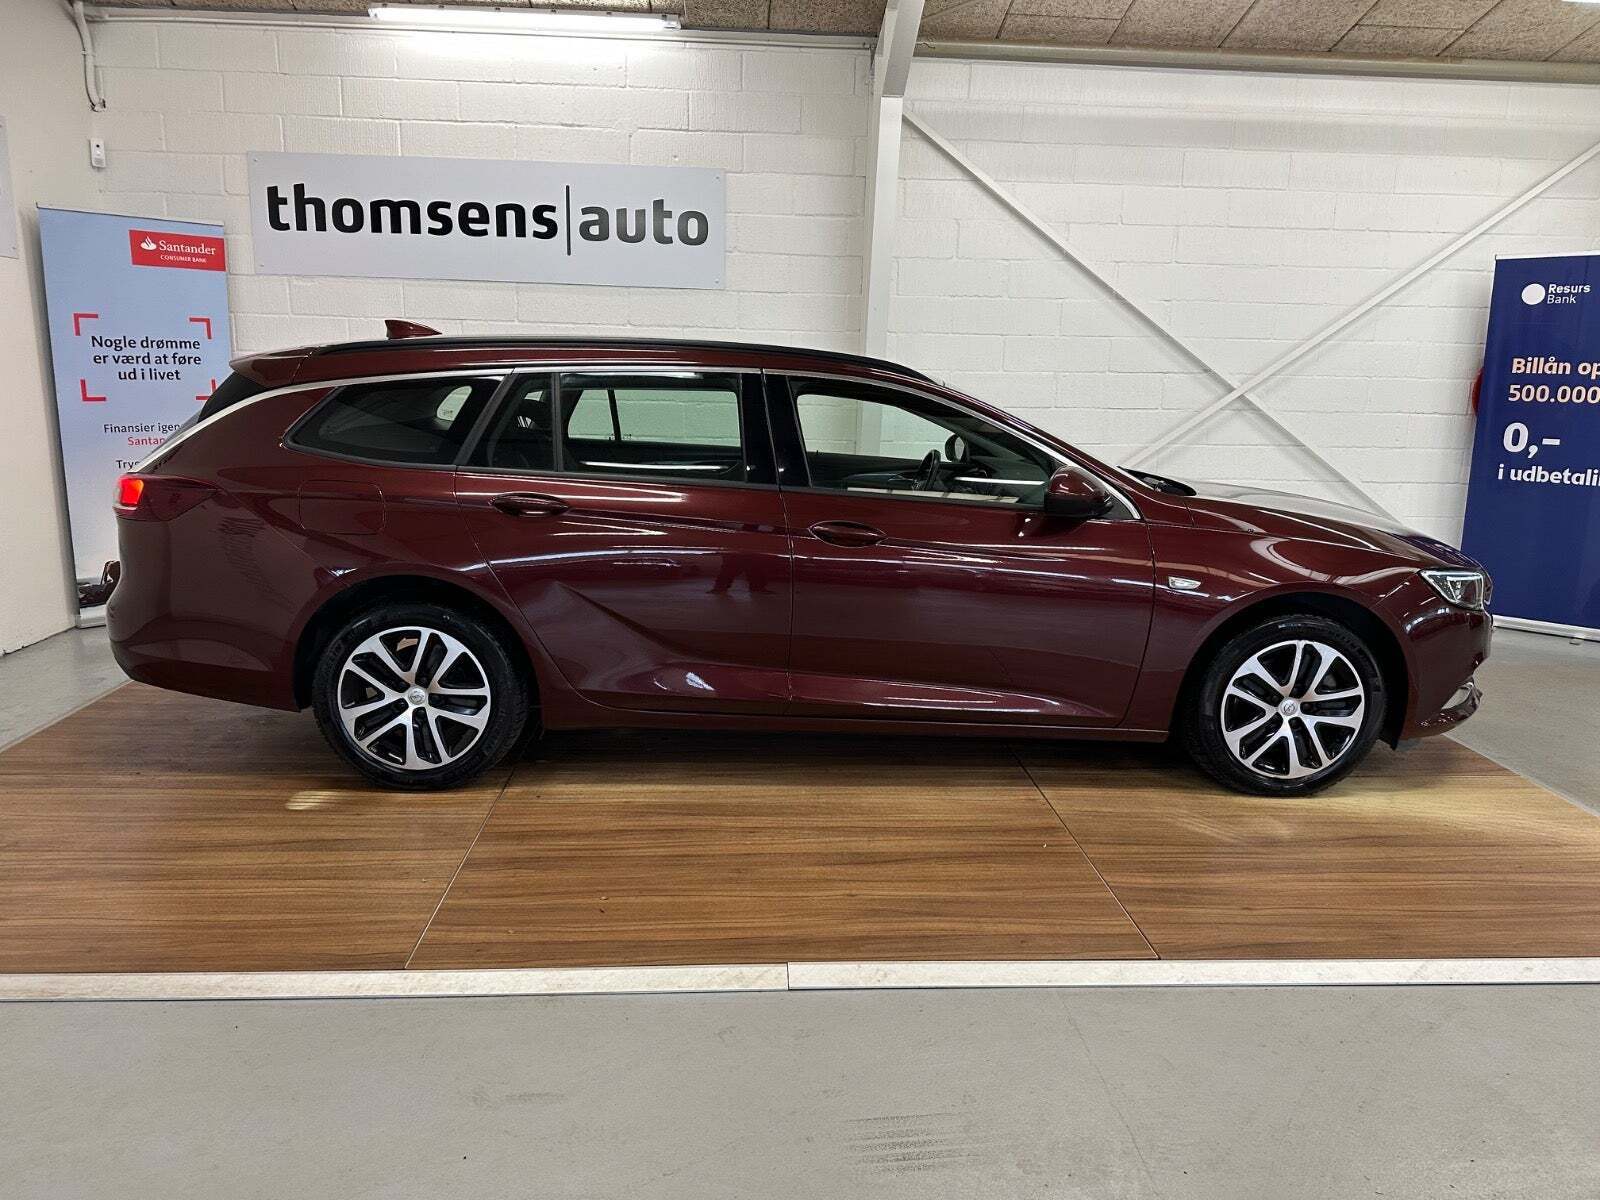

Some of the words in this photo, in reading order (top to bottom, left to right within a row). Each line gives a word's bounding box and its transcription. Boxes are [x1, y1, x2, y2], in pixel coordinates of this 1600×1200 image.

[266, 182, 558, 240] thomsens
[578, 198, 709, 246] auto
[159, 240, 216, 255] Santander
[160, 254, 191, 262] CONSUMER
[1548, 283, 1591, 294] Resurs
[1547, 294, 1577, 304] Bank
[91, 335, 137, 352] Nogle
[140, 336, 201, 350] drømme
[93, 354, 109, 364] er
[112, 352, 151, 365] værd
[154, 356, 169, 365] at
[171, 353, 202, 366] føre
[1511, 356, 1571, 375] Billån
[118, 368, 137, 380] ud
[141, 368, 145, 380] i
[149, 368, 182, 381] livet
[1508, 384, 1600, 404] 500.000
[103, 424, 155, 433] Finansier
[1497, 463, 1504, 480] i
[1510, 466, 1600, 487] udbetali
